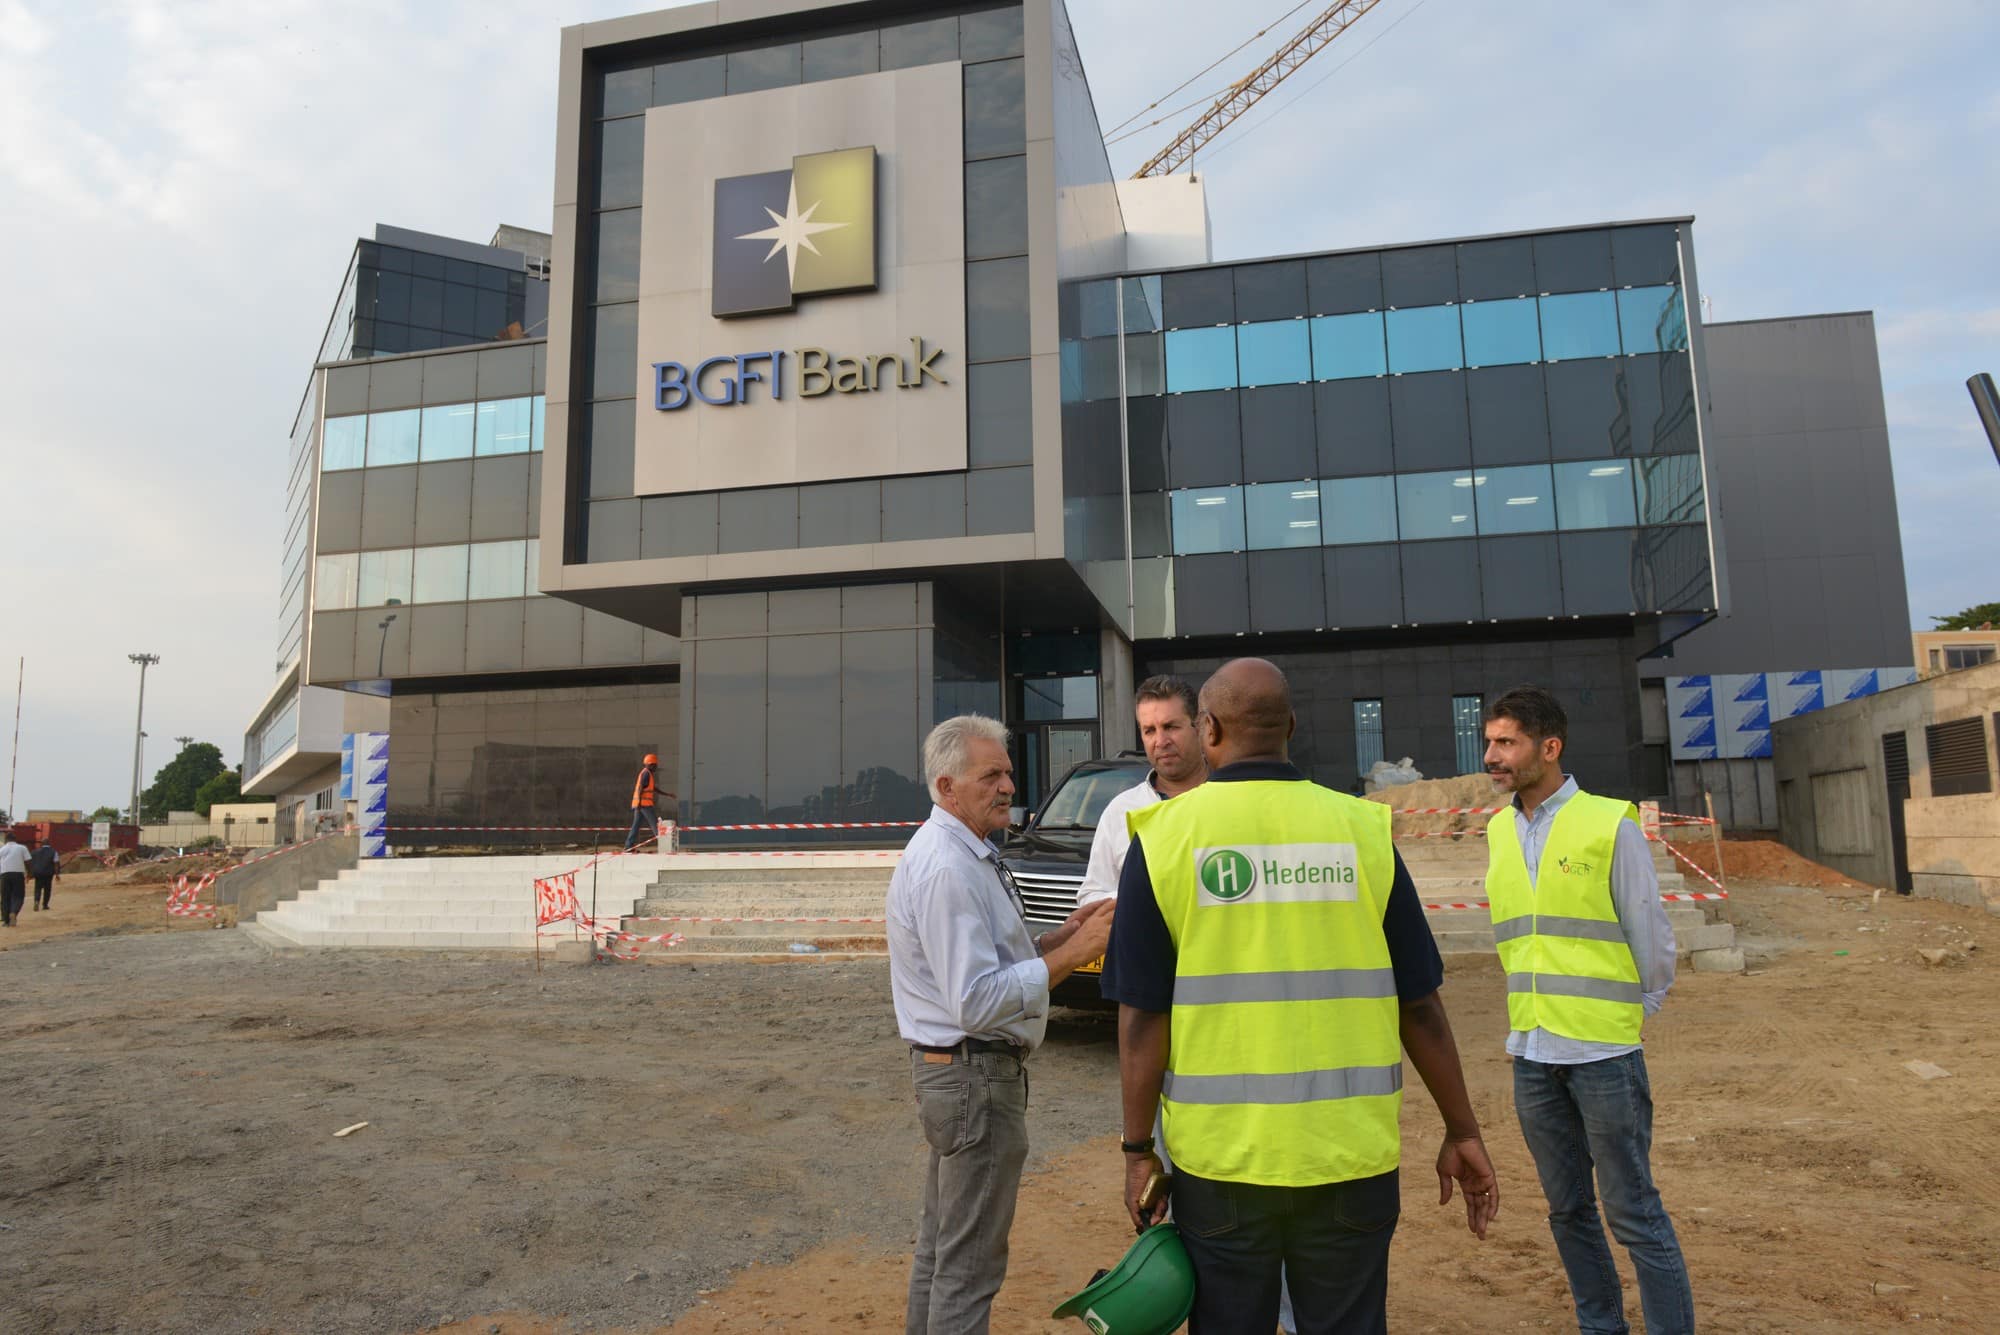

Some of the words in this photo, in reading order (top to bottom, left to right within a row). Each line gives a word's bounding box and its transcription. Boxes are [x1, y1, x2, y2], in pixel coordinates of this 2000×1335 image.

[651, 350, 785, 411] BGFI
[794, 335, 948, 397] Bank
[1216, 856, 1238, 892] H
[1262, 859, 1354, 885] Hedenia
